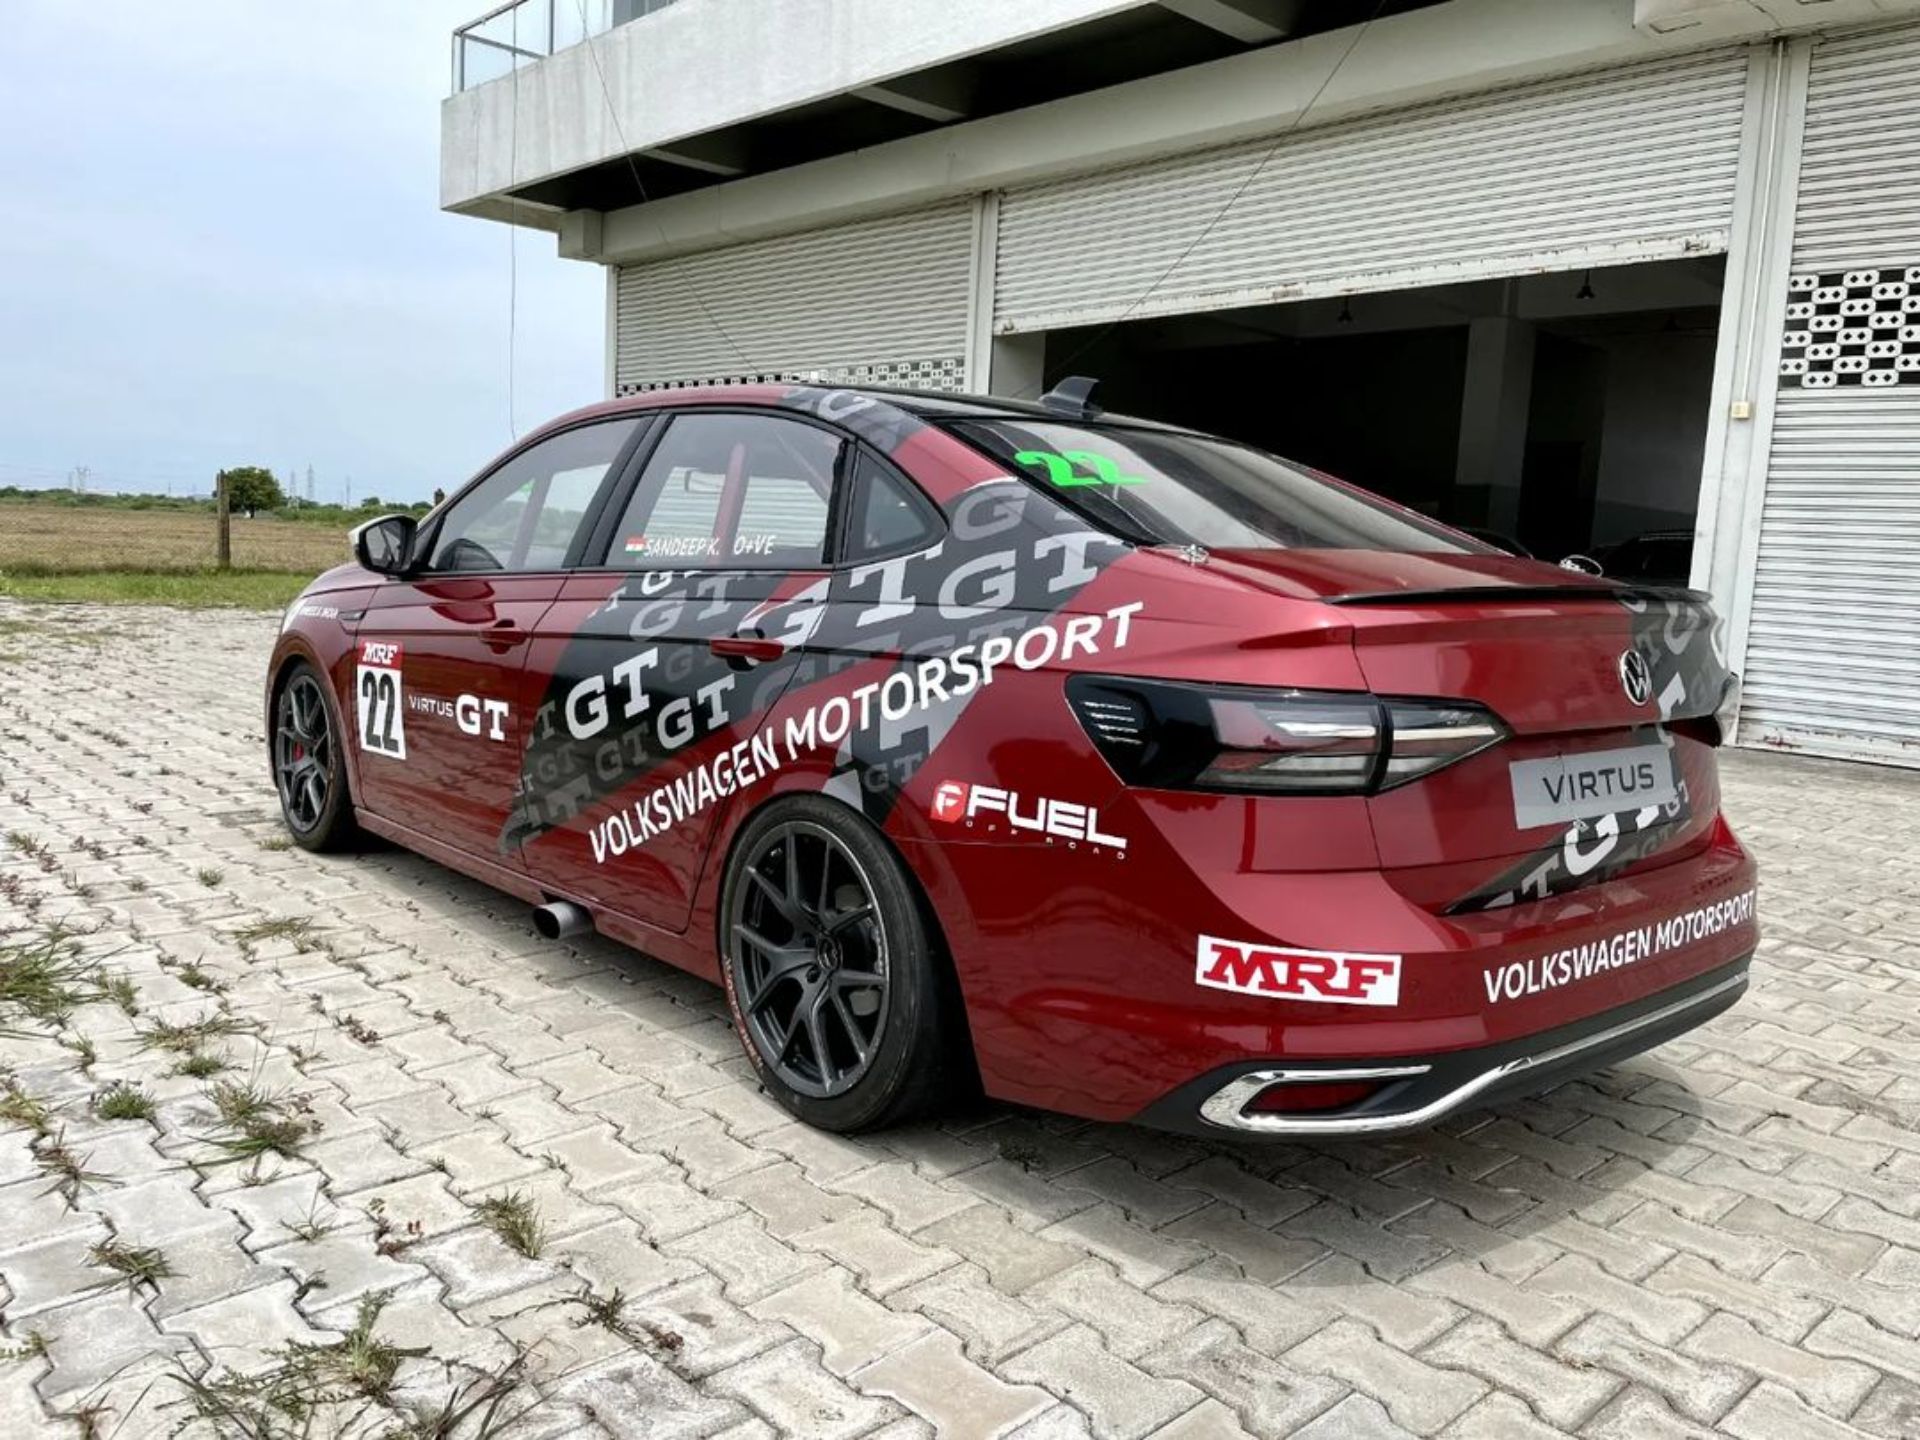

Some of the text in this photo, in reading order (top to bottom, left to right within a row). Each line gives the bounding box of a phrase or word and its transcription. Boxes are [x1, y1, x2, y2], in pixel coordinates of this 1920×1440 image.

[1014, 450, 1150, 489] 22
[643, 536, 706, 557] SANDEEP
[938, 532, 1134, 620] GT
[362, 642, 398, 666] MRF
[362, 671, 399, 753] 22
[408, 694, 509, 742] VIRTUS GT
[565, 647, 659, 740] GT
[657, 673, 735, 750] GT
[589, 727, 780, 864] VOLKSWAGEN
[785, 601, 1144, 761] MOTORSPORT
[1542, 763, 1655, 803] VIRTUS
[966, 784, 1127, 850] FUEL
[1202, 943, 1395, 999] MRF
[1484, 890, 1756, 1004] VOLKSWAGEN MOTORSPORT
